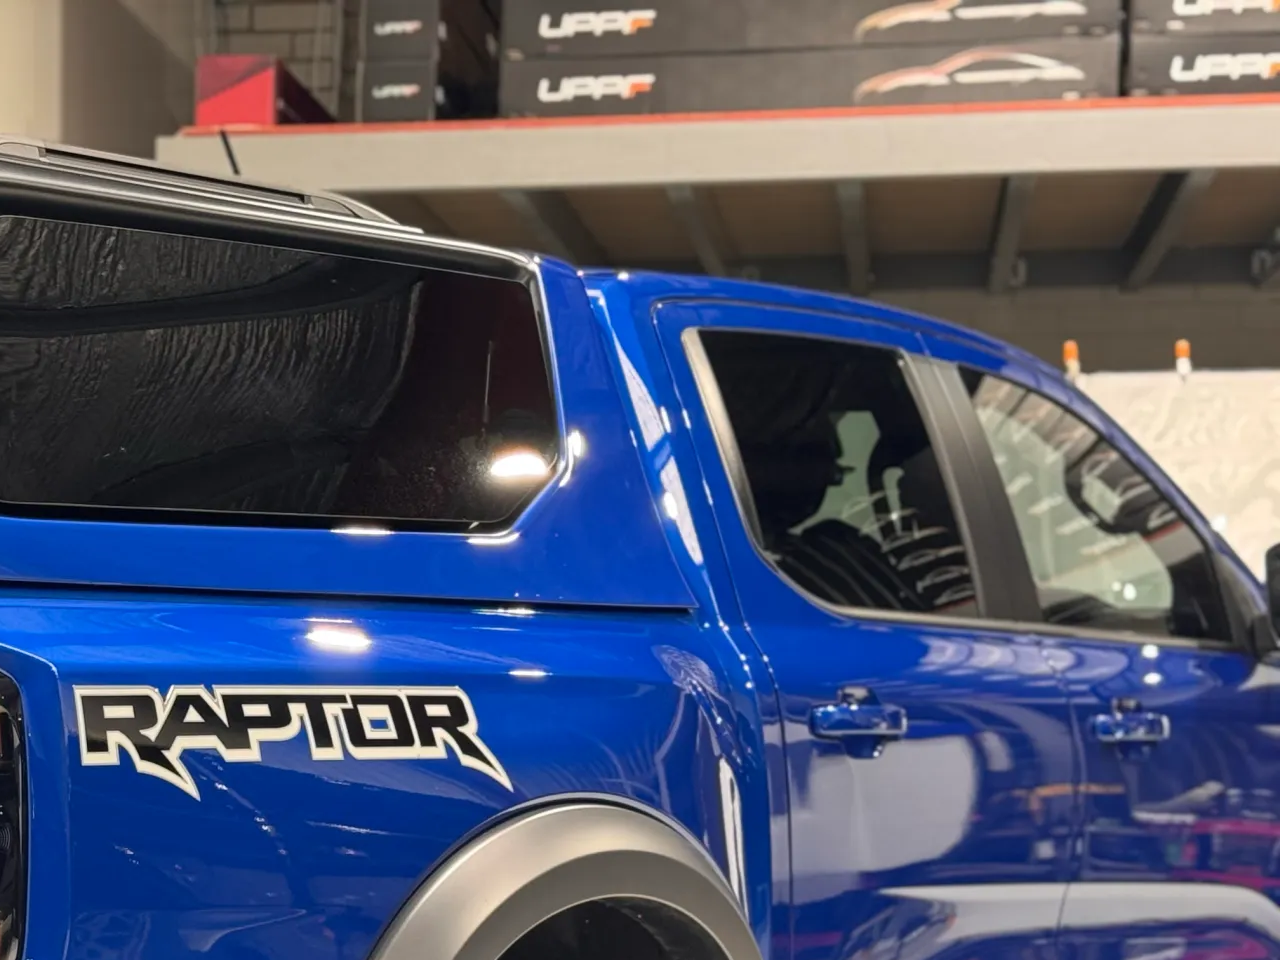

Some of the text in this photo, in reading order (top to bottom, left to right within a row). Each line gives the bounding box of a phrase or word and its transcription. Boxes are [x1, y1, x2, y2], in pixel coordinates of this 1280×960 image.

[538, 9, 657, 38] UPPF
[537, 73, 656, 102] UPPF
[73, 685, 513, 801] RAPTOR
